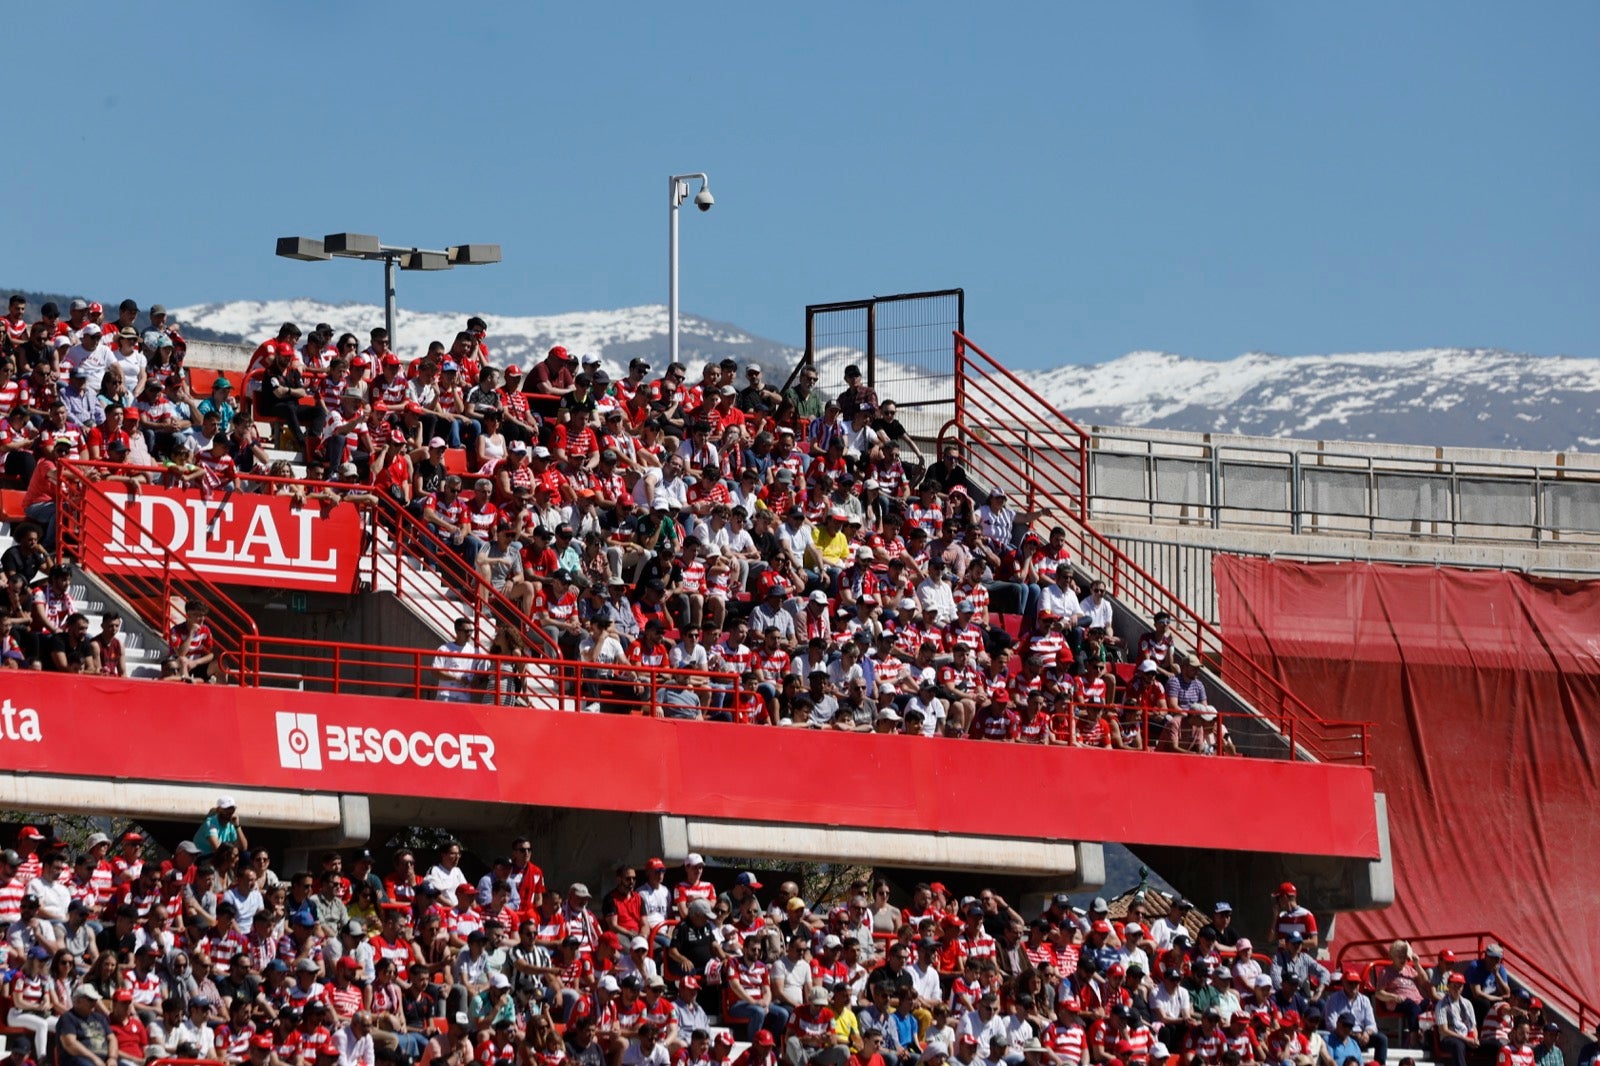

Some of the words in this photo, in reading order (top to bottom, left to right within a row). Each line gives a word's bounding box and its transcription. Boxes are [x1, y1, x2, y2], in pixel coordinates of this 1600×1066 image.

[103, 491, 337, 570] IDEAL
[0, 699, 43, 743] ta
[325, 725, 497, 771] BESOCCER
